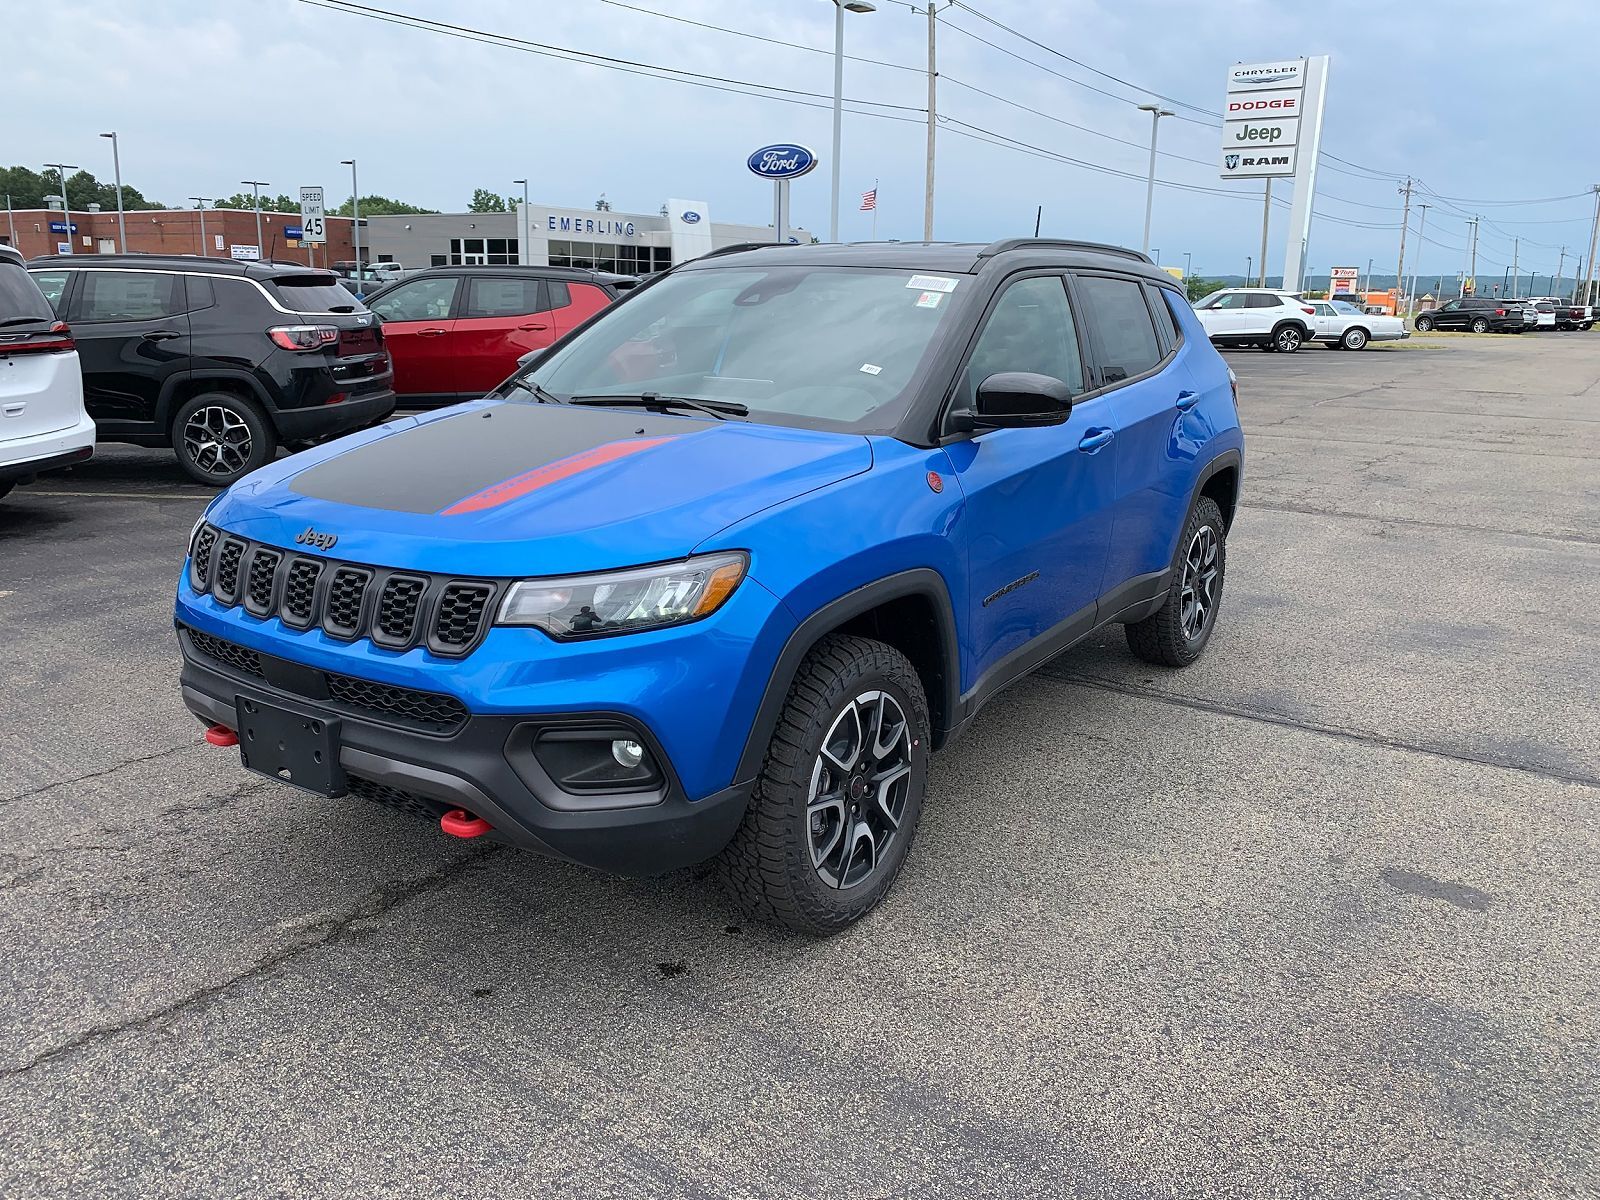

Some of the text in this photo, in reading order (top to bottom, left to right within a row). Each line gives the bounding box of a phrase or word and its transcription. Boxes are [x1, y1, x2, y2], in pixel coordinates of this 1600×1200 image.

[1234, 67, 1297, 77] CHRYSLER
[1229, 99, 1296, 111] DODGE
[1236, 125, 1282, 142] Jeep
[760, 150, 799, 172] Ford
[1242, 156, 1289, 166] RAM
[302, 193, 321, 201] SPEED
[304, 206, 320, 214] LIMIT
[305, 218, 323, 236] 45
[548, 216, 634, 236] EMERLING
[295, 527, 338, 552] Jeep
